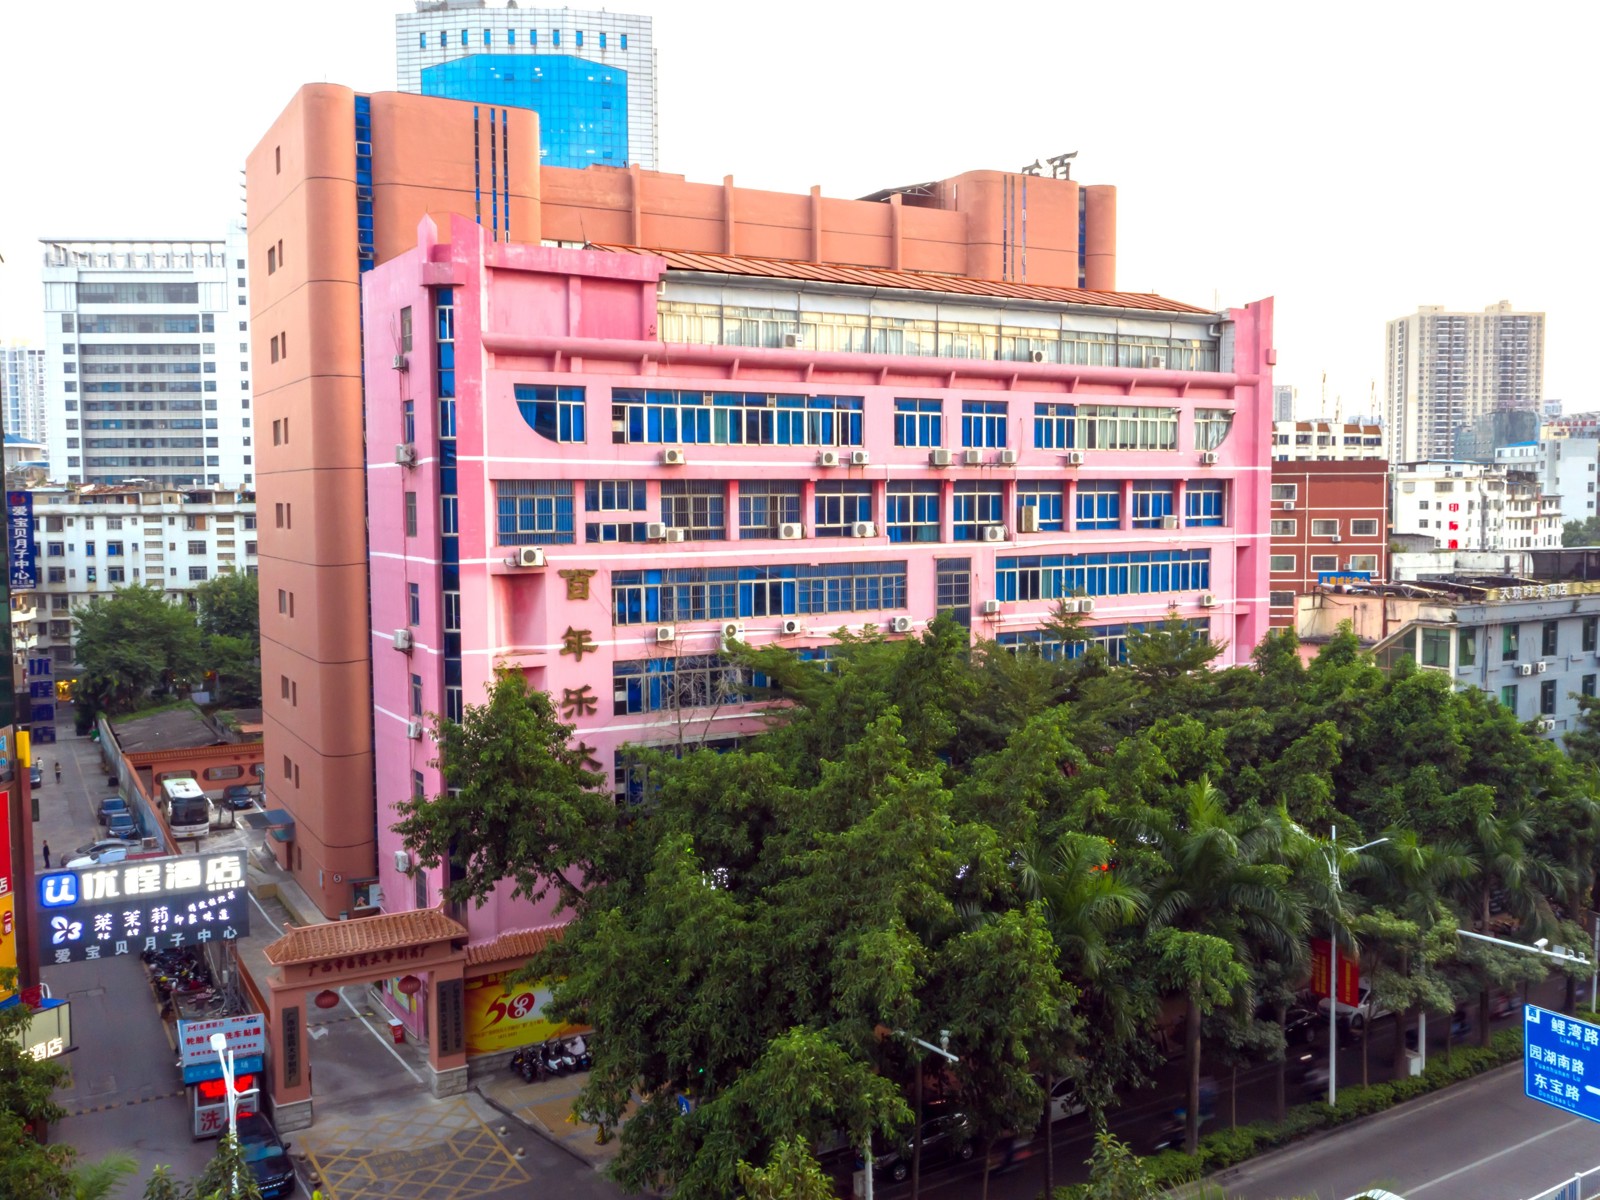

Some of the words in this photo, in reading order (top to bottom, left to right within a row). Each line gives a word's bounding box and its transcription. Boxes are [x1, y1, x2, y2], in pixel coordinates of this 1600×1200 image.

[12, 506, 30, 580] 爱宝贝月子中心
[82, 855, 241, 901] 优程酒店
[54, 926, 238, 964] 爱宝贝月子中心
[1551, 1017, 1599, 1046] 鲤湾路
[1530, 1044, 1585, 1076] 园湖南路
[1534, 1073, 1580, 1102] 东宝路
